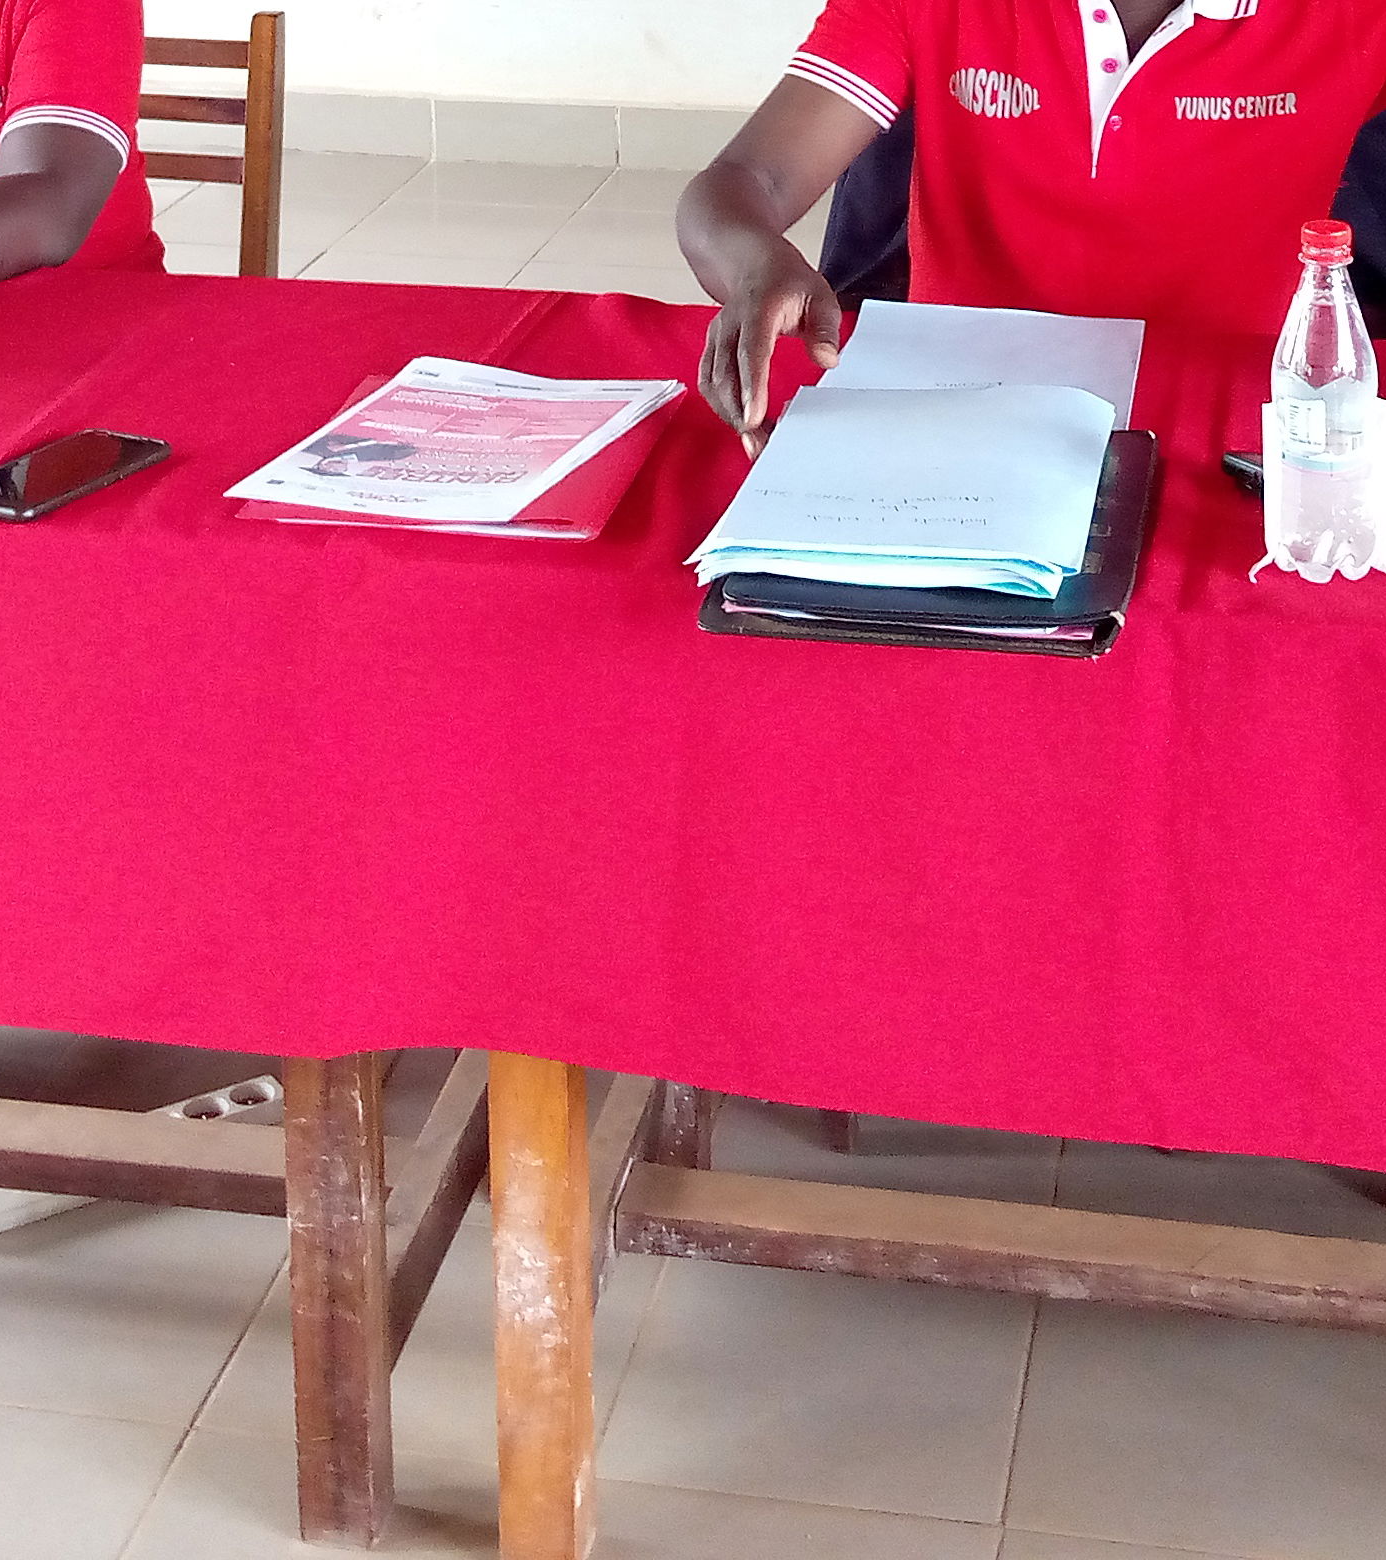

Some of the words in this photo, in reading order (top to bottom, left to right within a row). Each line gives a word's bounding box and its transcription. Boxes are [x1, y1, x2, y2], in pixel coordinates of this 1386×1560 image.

[948, 67, 1041, 119] CAMSCHOOL
[1174, 95, 1232, 121] YUNUS
[1234, 91, 1298, 120] CENTER
